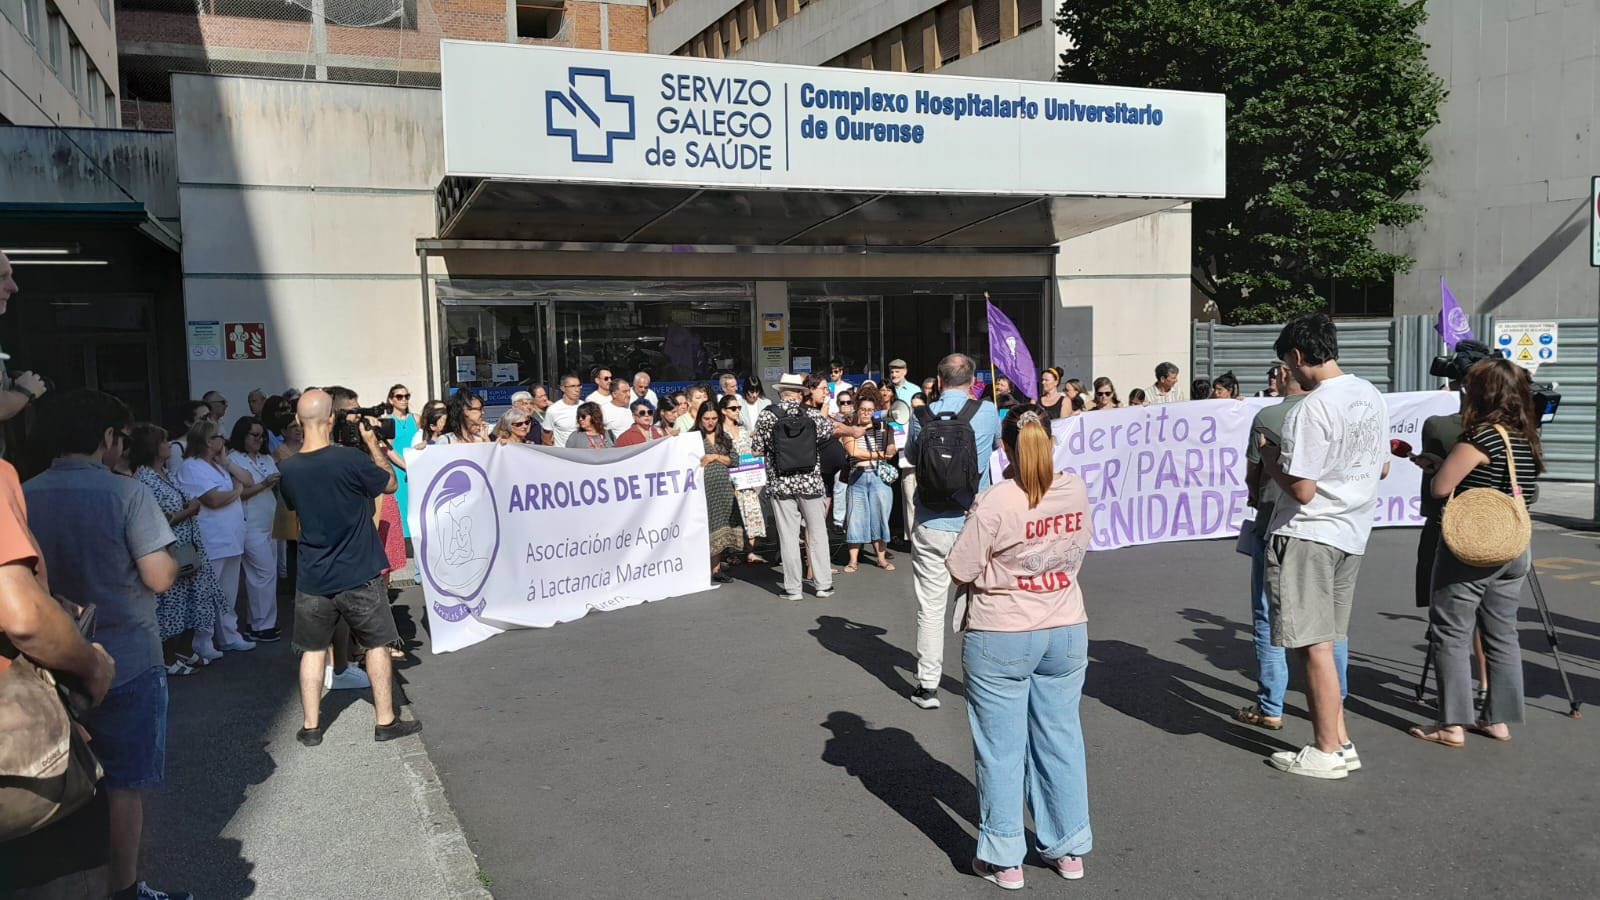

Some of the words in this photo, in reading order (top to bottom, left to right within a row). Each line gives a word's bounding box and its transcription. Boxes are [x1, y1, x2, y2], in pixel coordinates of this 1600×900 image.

[660, 72, 772, 107] SERVIZO
[800, 82, 909, 117] Complexo
[915, 89, 1038, 121] Hospitalario
[1045, 97, 1163, 127] Universitario
[656, 106, 772, 139] GALEGO
[800, 114, 828, 140] de
[835, 117, 925, 144] Ourense
[645, 135, 676, 167] de
[685, 138, 772, 171] SAÚDE
[1068, 406, 1190, 455] dereito
[1200, 416, 1217, 444] a
[508, 477, 610, 513] ARROLOS
[614, 474, 642, 502] DE
[644, 468, 697, 497] TETA
[1025, 511, 1083, 540] COFFEE
[1088, 489, 1249, 549] GNIDADE
[526, 532, 612, 564] Asociación
[615, 530, 631, 550] de
[636, 522, 680, 549] Apoio
[527, 582, 536, 602] á
[540, 568, 611, 599] Lactancia
[616, 555, 683, 584] Materna
[1017, 569, 1071, 591] CLUB
